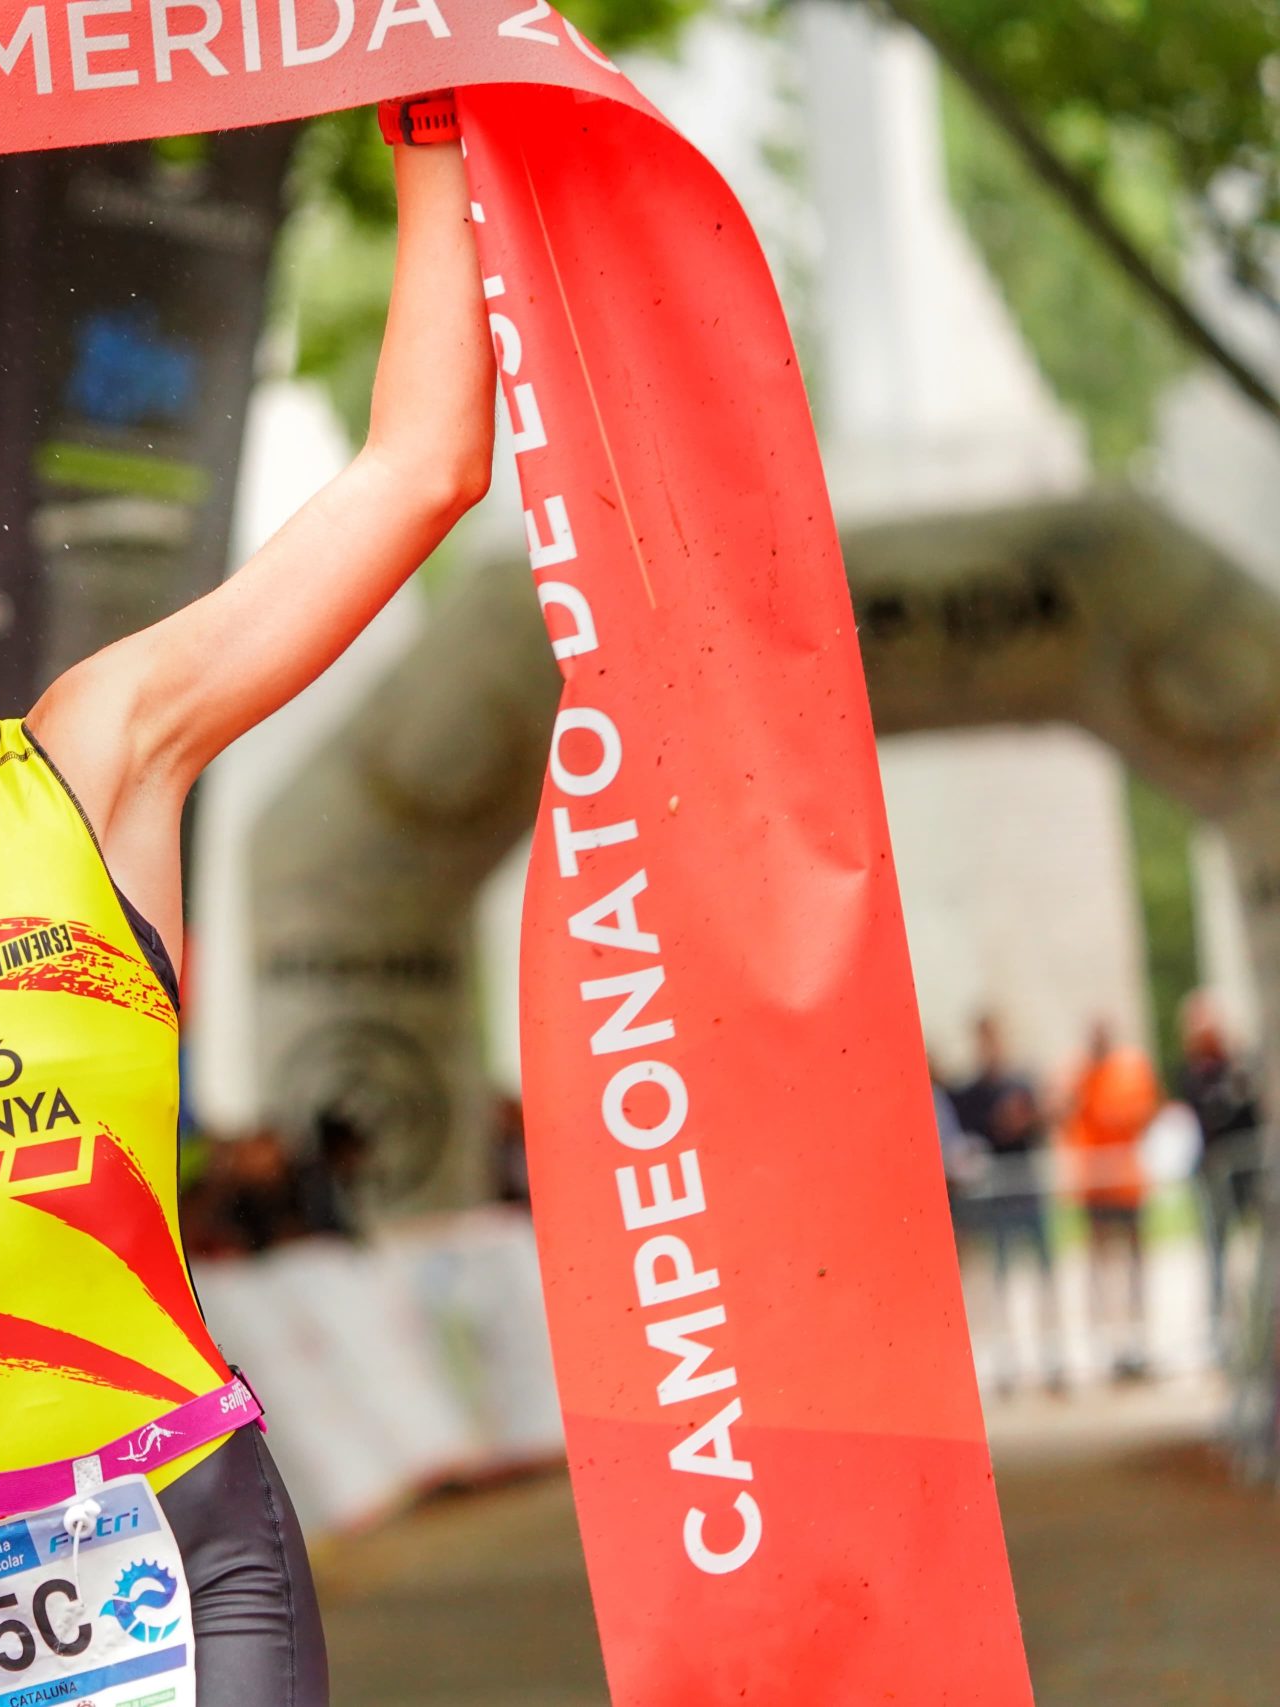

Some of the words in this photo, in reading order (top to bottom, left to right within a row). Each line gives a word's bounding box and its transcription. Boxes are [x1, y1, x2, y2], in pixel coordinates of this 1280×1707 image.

[523, 495, 598, 661] DE
[549, 707, 762, 1574] CAMPEONATO
[50, 1507, 138, 1553] Ftri
[9, 1681, 78, 1707] CATALUÑA
